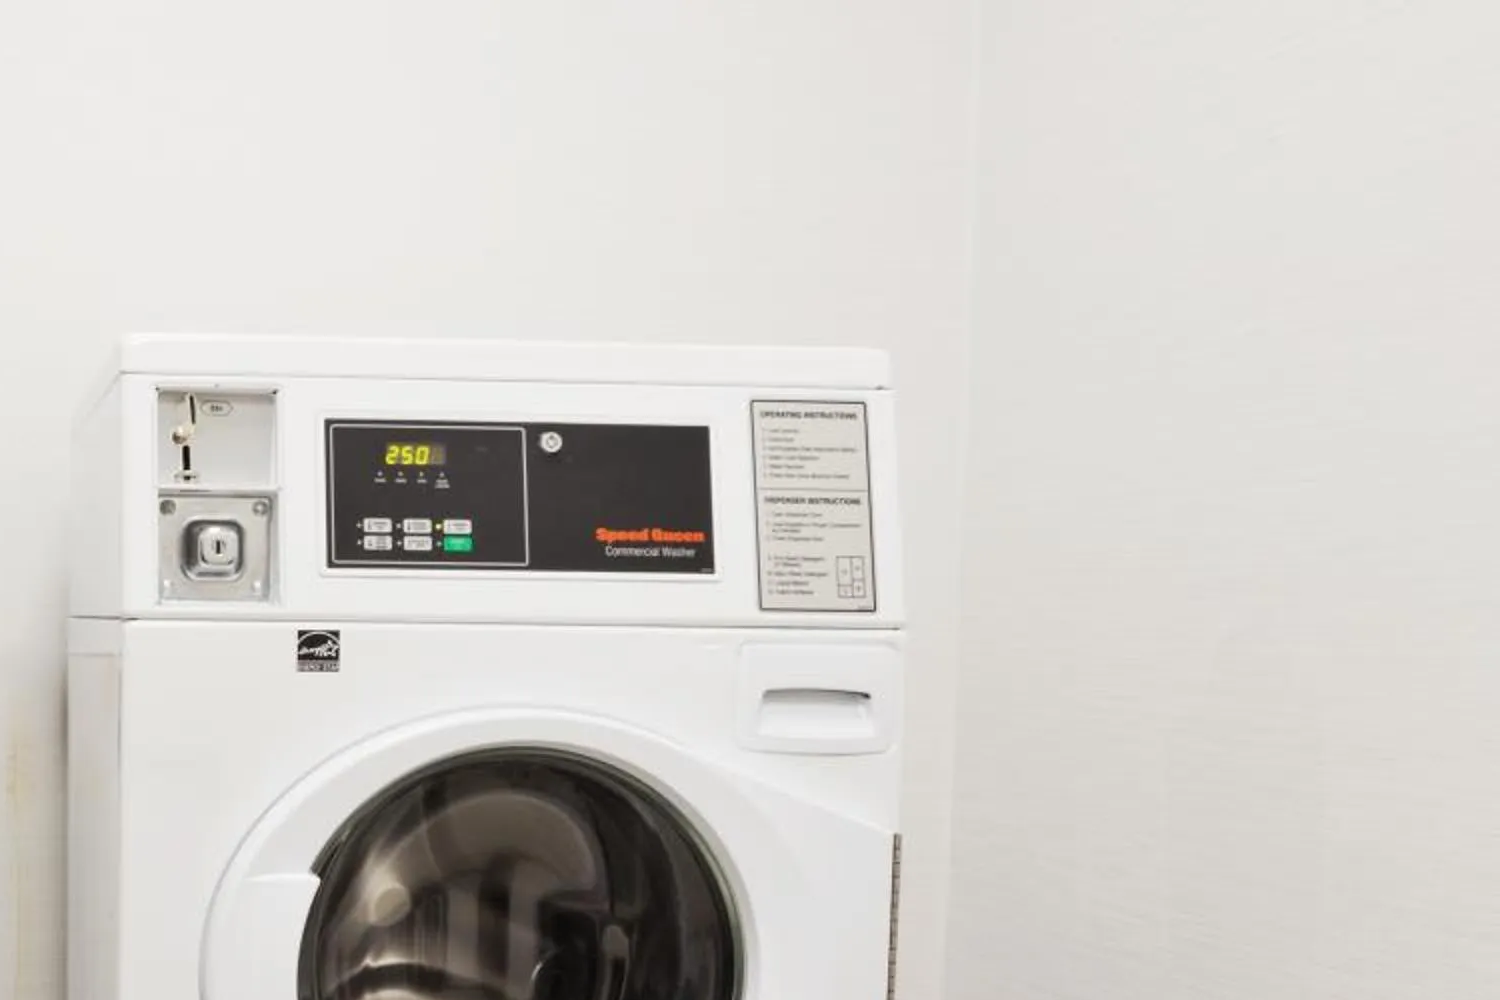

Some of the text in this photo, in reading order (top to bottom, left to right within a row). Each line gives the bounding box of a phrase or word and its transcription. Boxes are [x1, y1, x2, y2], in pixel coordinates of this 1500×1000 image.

[385, 444, 430, 466] 250
[595, 527, 706, 543] Speed Queen
[605, 545, 696, 557] Commercial Washer
